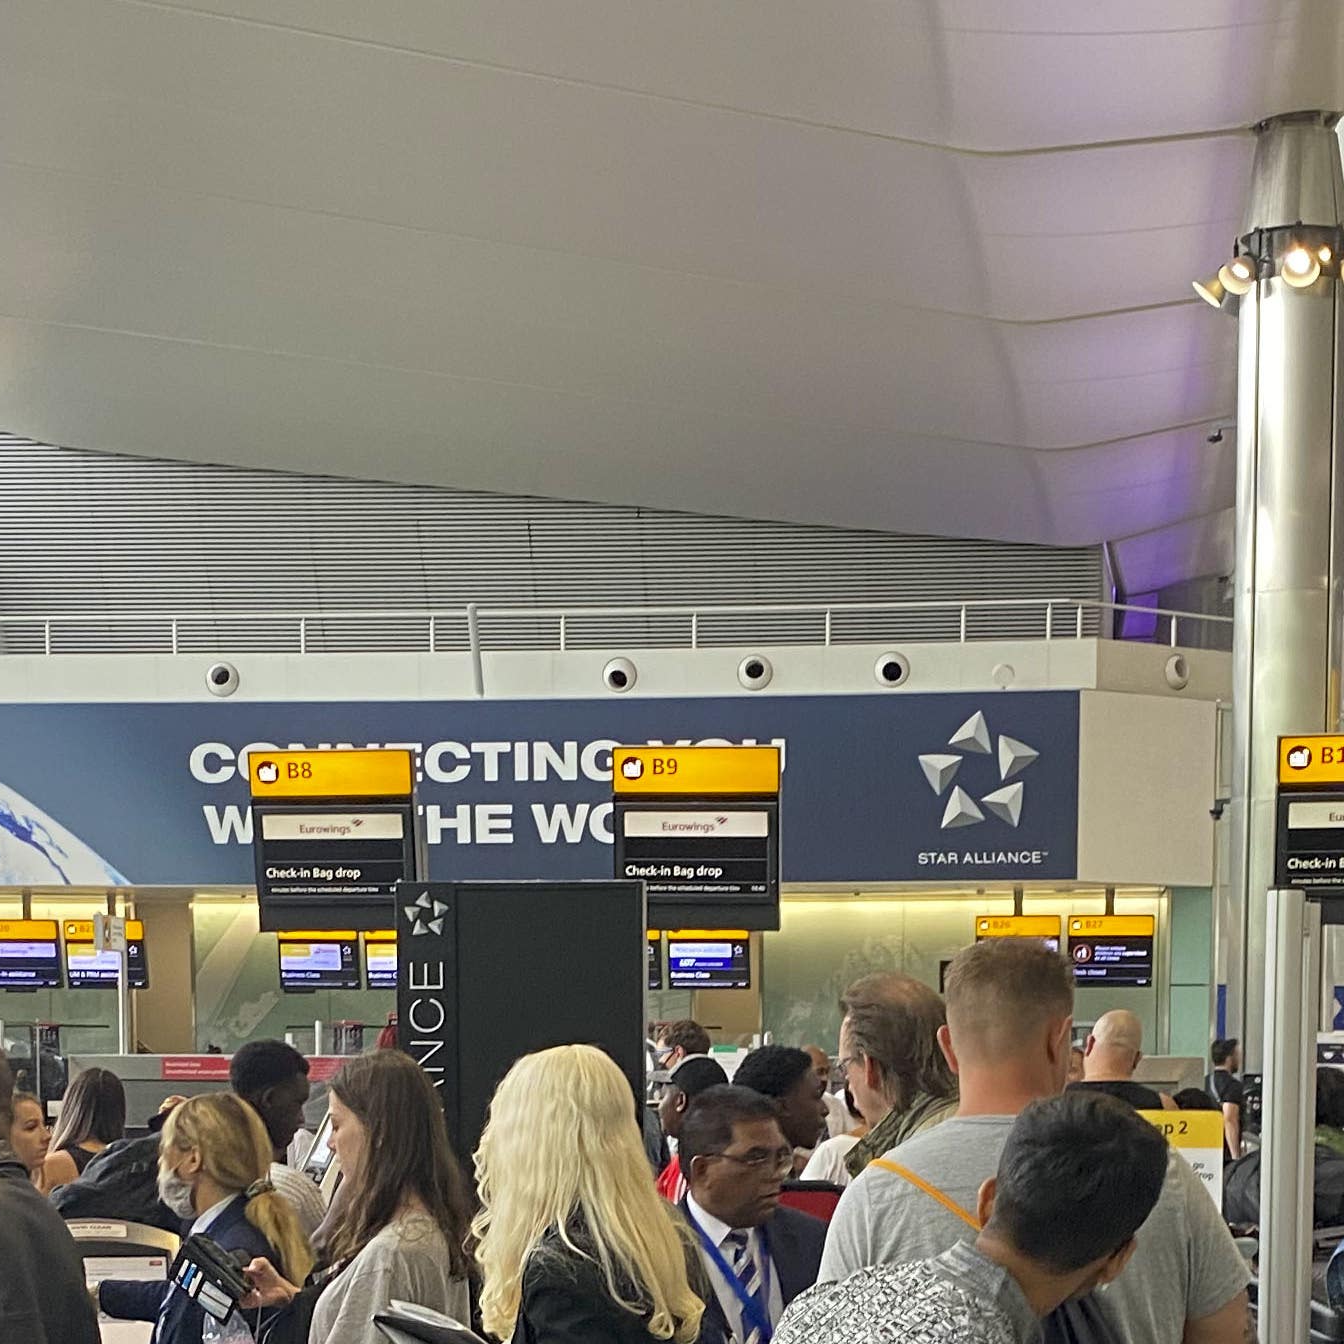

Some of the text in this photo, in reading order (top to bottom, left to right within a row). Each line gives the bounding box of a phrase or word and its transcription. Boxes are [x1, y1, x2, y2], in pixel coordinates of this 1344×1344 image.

[286, 761, 313, 780] B8
[652, 757, 678, 776] B9
[299, 824, 352, 836] Eurowings
[418, 804, 514, 845] HE
[661, 821, 716, 833] Eurowings
[917, 851, 958, 865] STAR
[1287, 856, 1337, 870] Check-in
[265, 866, 361, 881] Check-in Bag drop
[625, 865, 723, 879] Check-in Bag drop
[408, 961, 446, 1087] NCE
[1178, 1120, 1188, 1135] 2
[1199, 1172, 1215, 1181] rop
